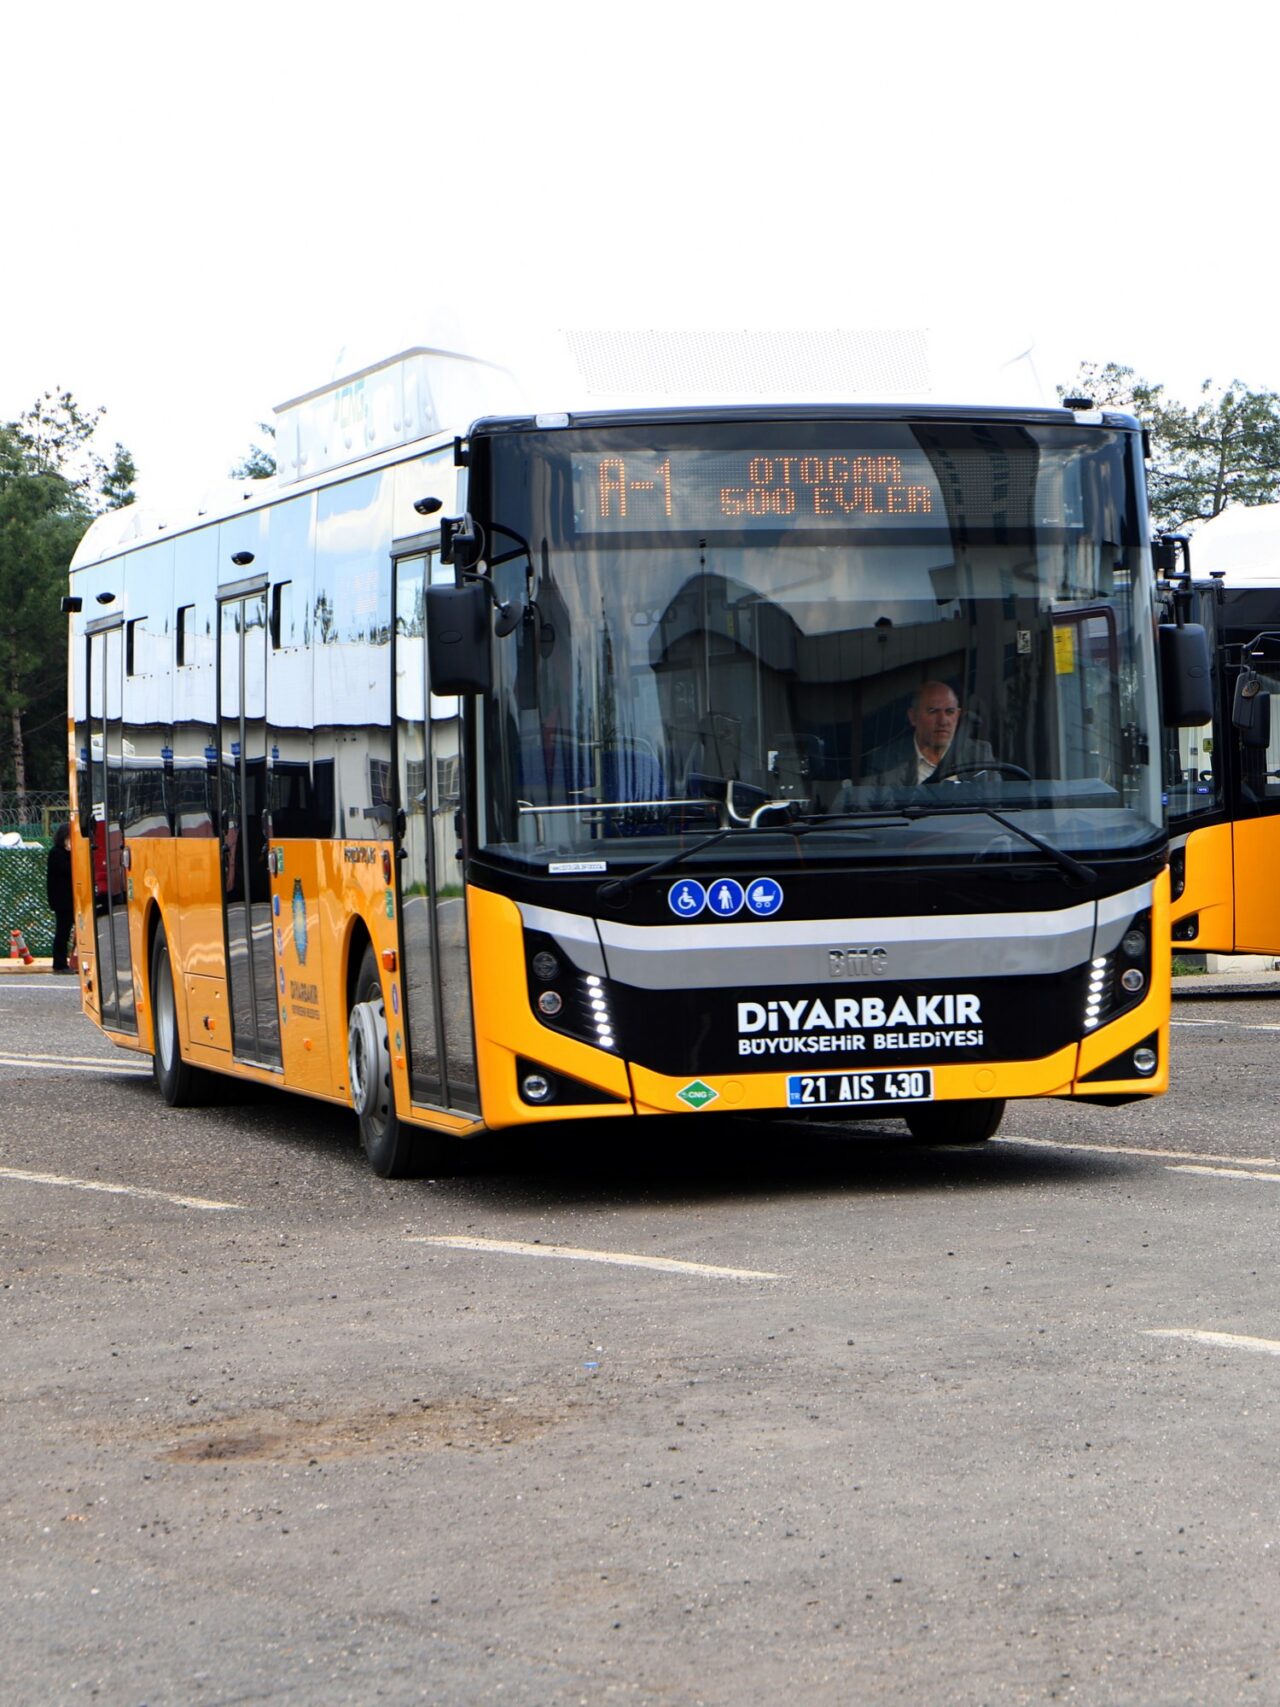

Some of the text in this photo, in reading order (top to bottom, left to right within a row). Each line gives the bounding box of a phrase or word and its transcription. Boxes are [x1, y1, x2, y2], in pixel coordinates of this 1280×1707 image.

[750, 456, 902, 485] OTOGAR
[600, 458, 672, 517] A-1
[720, 485, 933, 516] 500 EVLER
[801, 1078, 827, 1103] 21
[839, 1075, 875, 1101] AIS
[884, 1072, 924, 1098] 430
